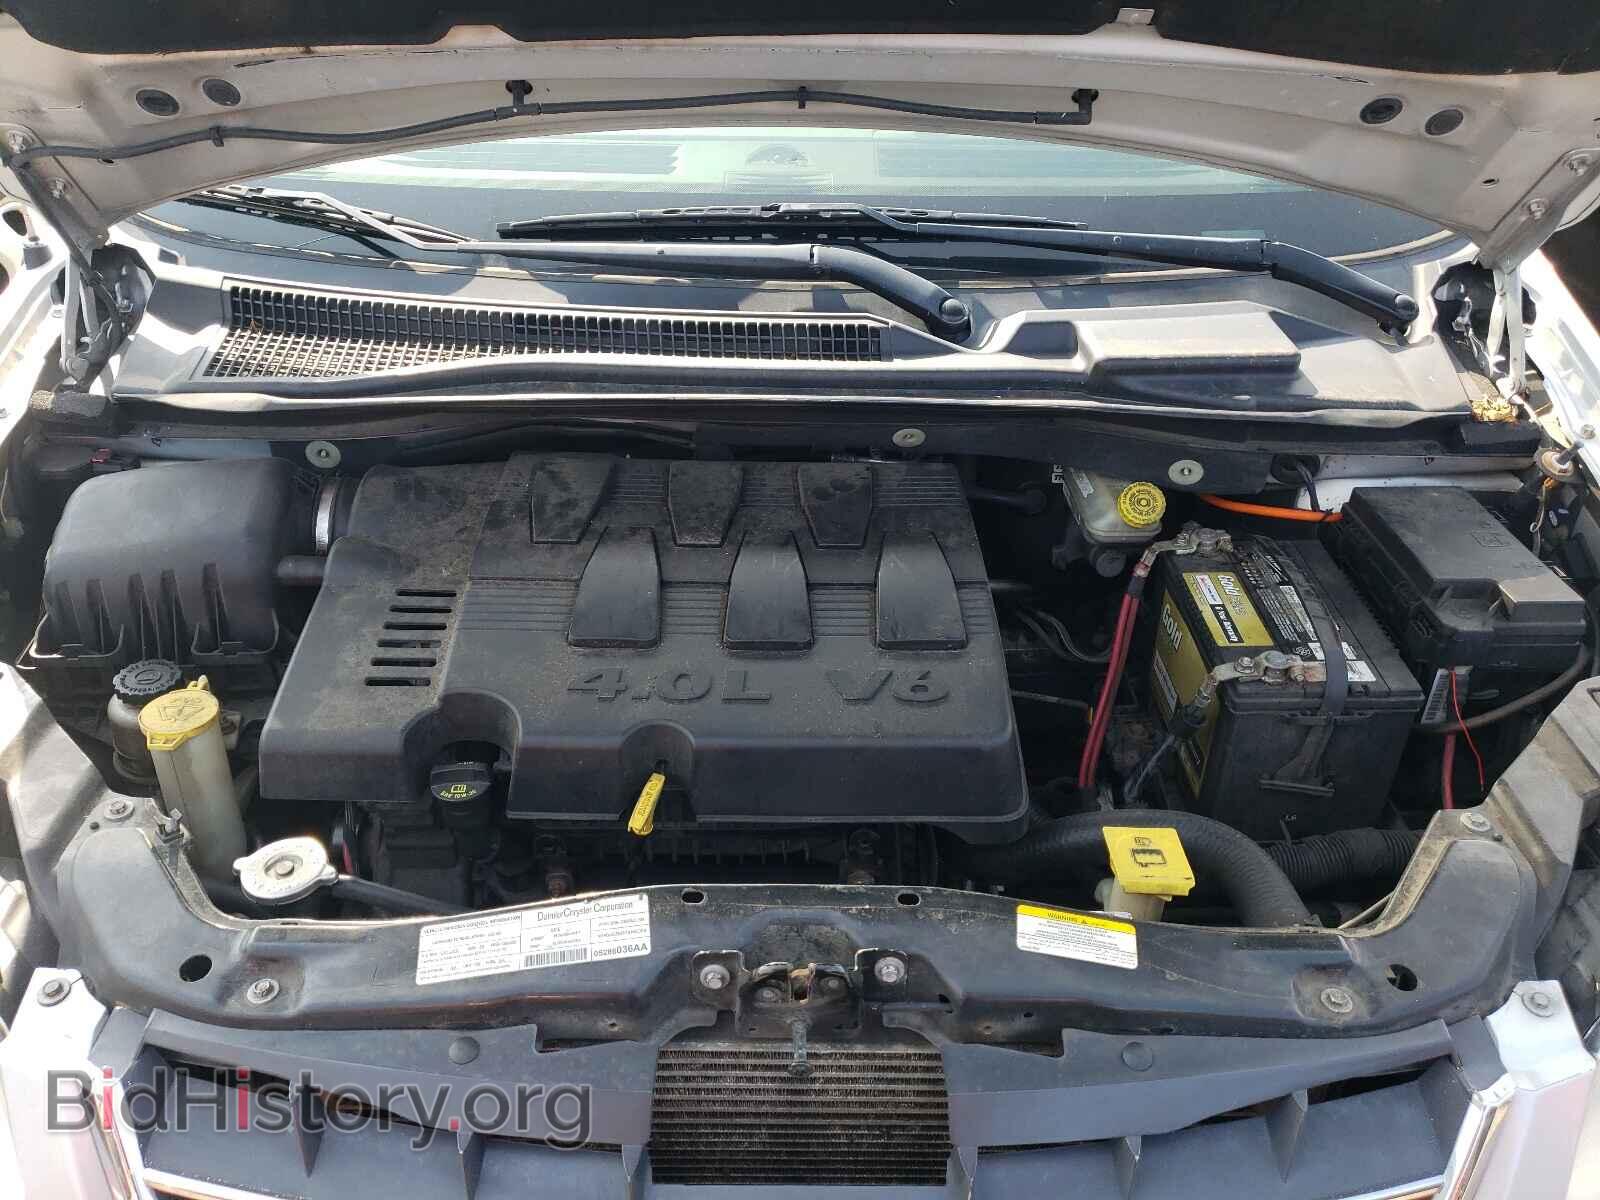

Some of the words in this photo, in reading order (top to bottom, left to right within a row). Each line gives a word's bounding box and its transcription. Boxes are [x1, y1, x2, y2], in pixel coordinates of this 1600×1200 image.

[1162, 603, 1183, 651] Gold
[567, 667, 774, 704] 4.0L
[826, 669, 951, 705] V6
